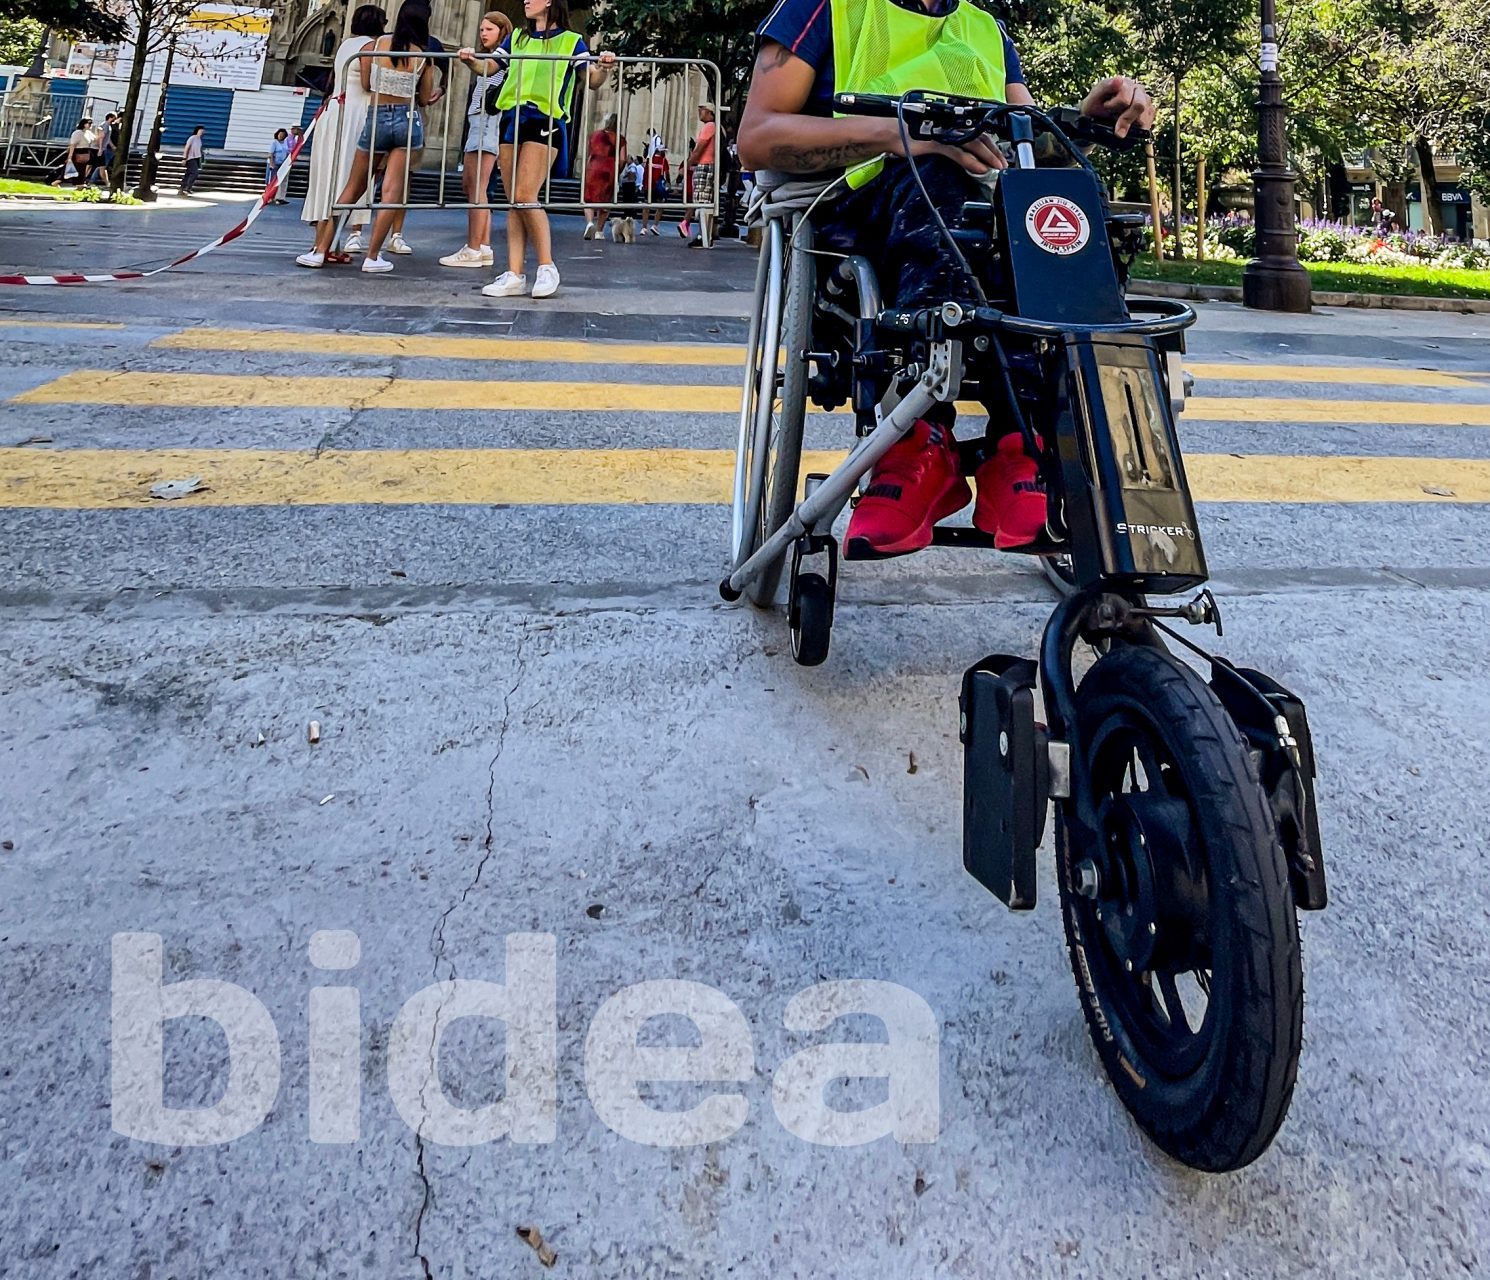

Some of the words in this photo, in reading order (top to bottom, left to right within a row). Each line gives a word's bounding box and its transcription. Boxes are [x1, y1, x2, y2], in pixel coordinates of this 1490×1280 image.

[1441, 192, 1463, 202] BBVA
[1029, 199, 1054, 221] BRAZILIAN
[1116, 523, 1184, 536] STRICKER
